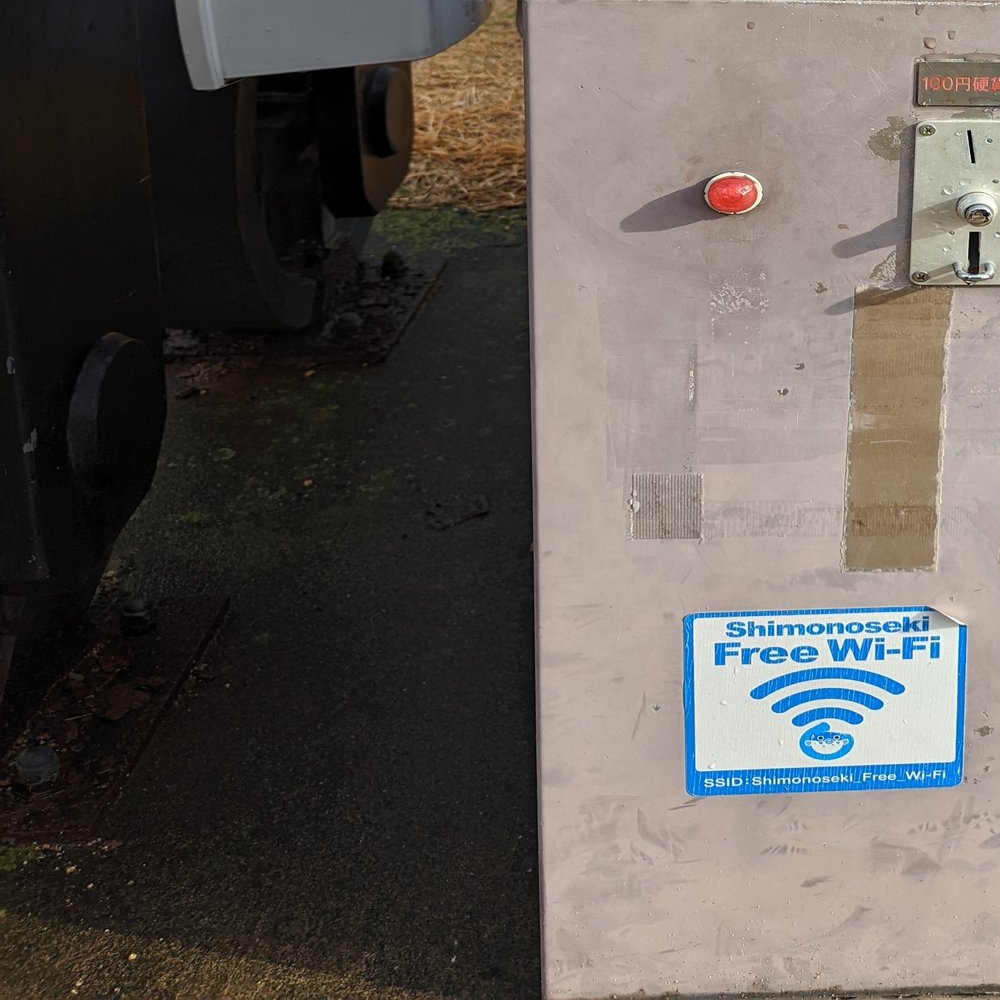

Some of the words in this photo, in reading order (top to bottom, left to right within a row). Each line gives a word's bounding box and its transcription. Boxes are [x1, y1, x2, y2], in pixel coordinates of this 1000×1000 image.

[725, 616, 930, 638] Shimonoseki
[714, 642, 819, 666] Free
[827, 636, 941, 662] Wi-Fi
